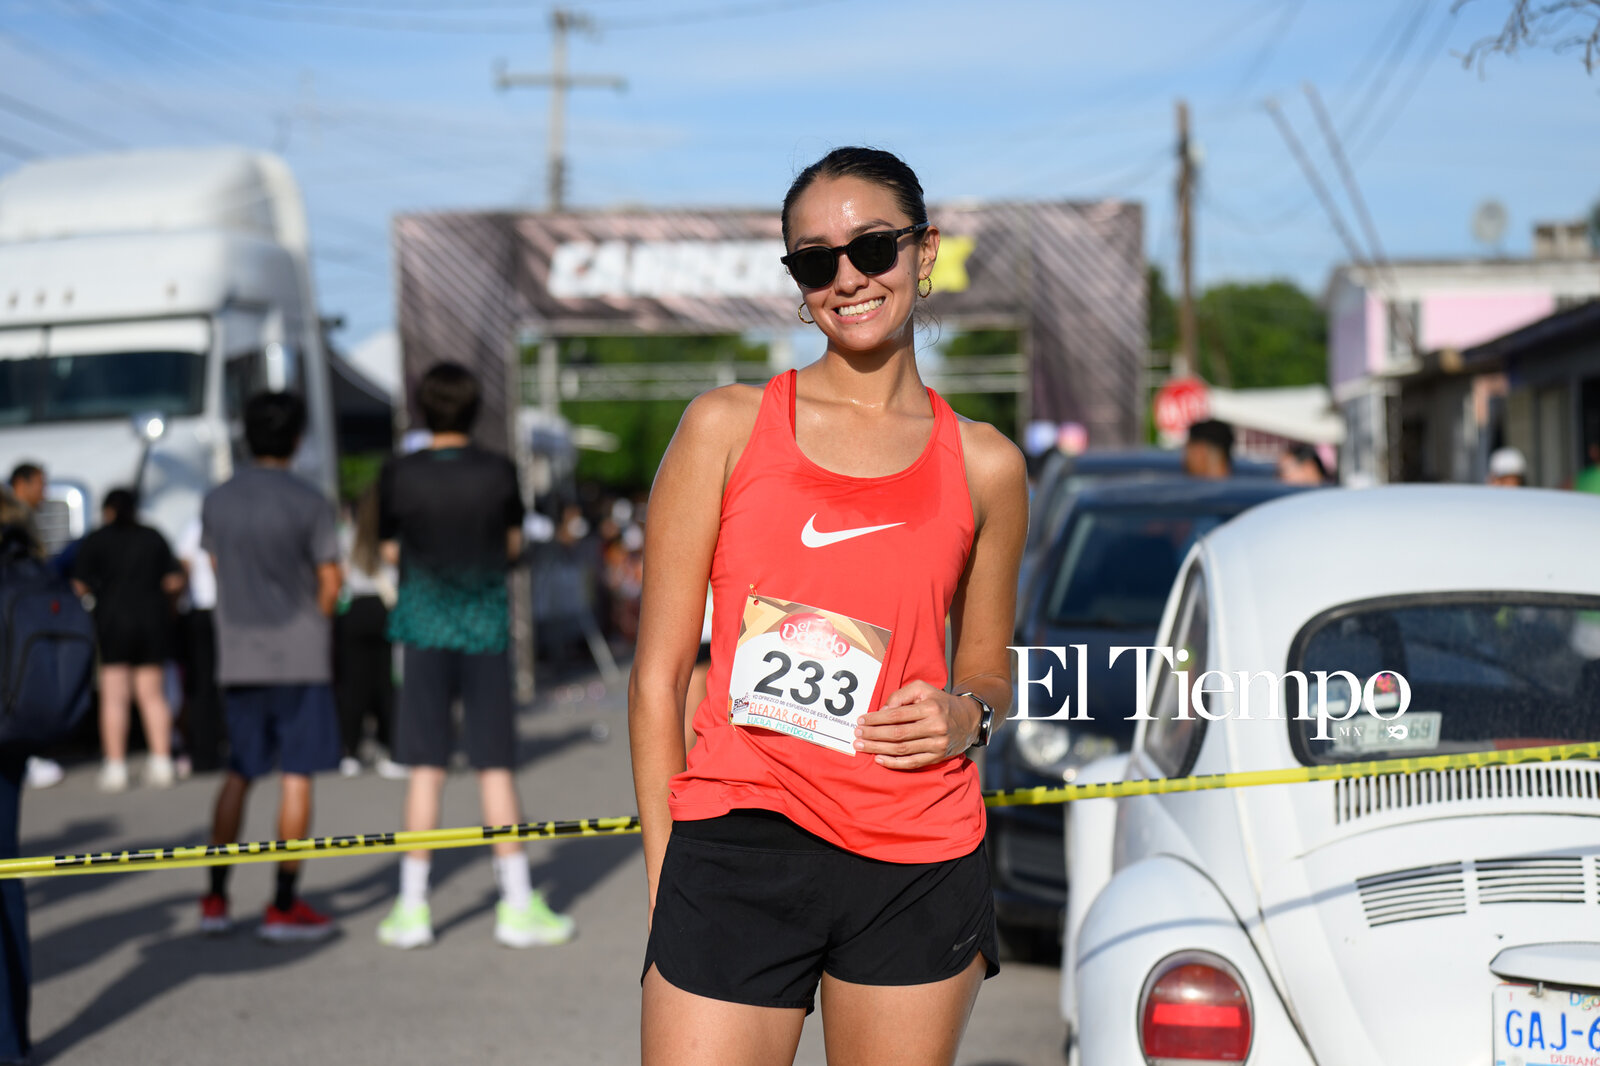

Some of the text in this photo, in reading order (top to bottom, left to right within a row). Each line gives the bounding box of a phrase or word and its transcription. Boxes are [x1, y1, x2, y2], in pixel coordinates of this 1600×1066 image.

[753, 650, 859, 717] 233
[748, 702, 789, 723] ELEAZAR
[791, 712, 818, 731] CASAS
[775, 721, 814, 740] MENDOZA
